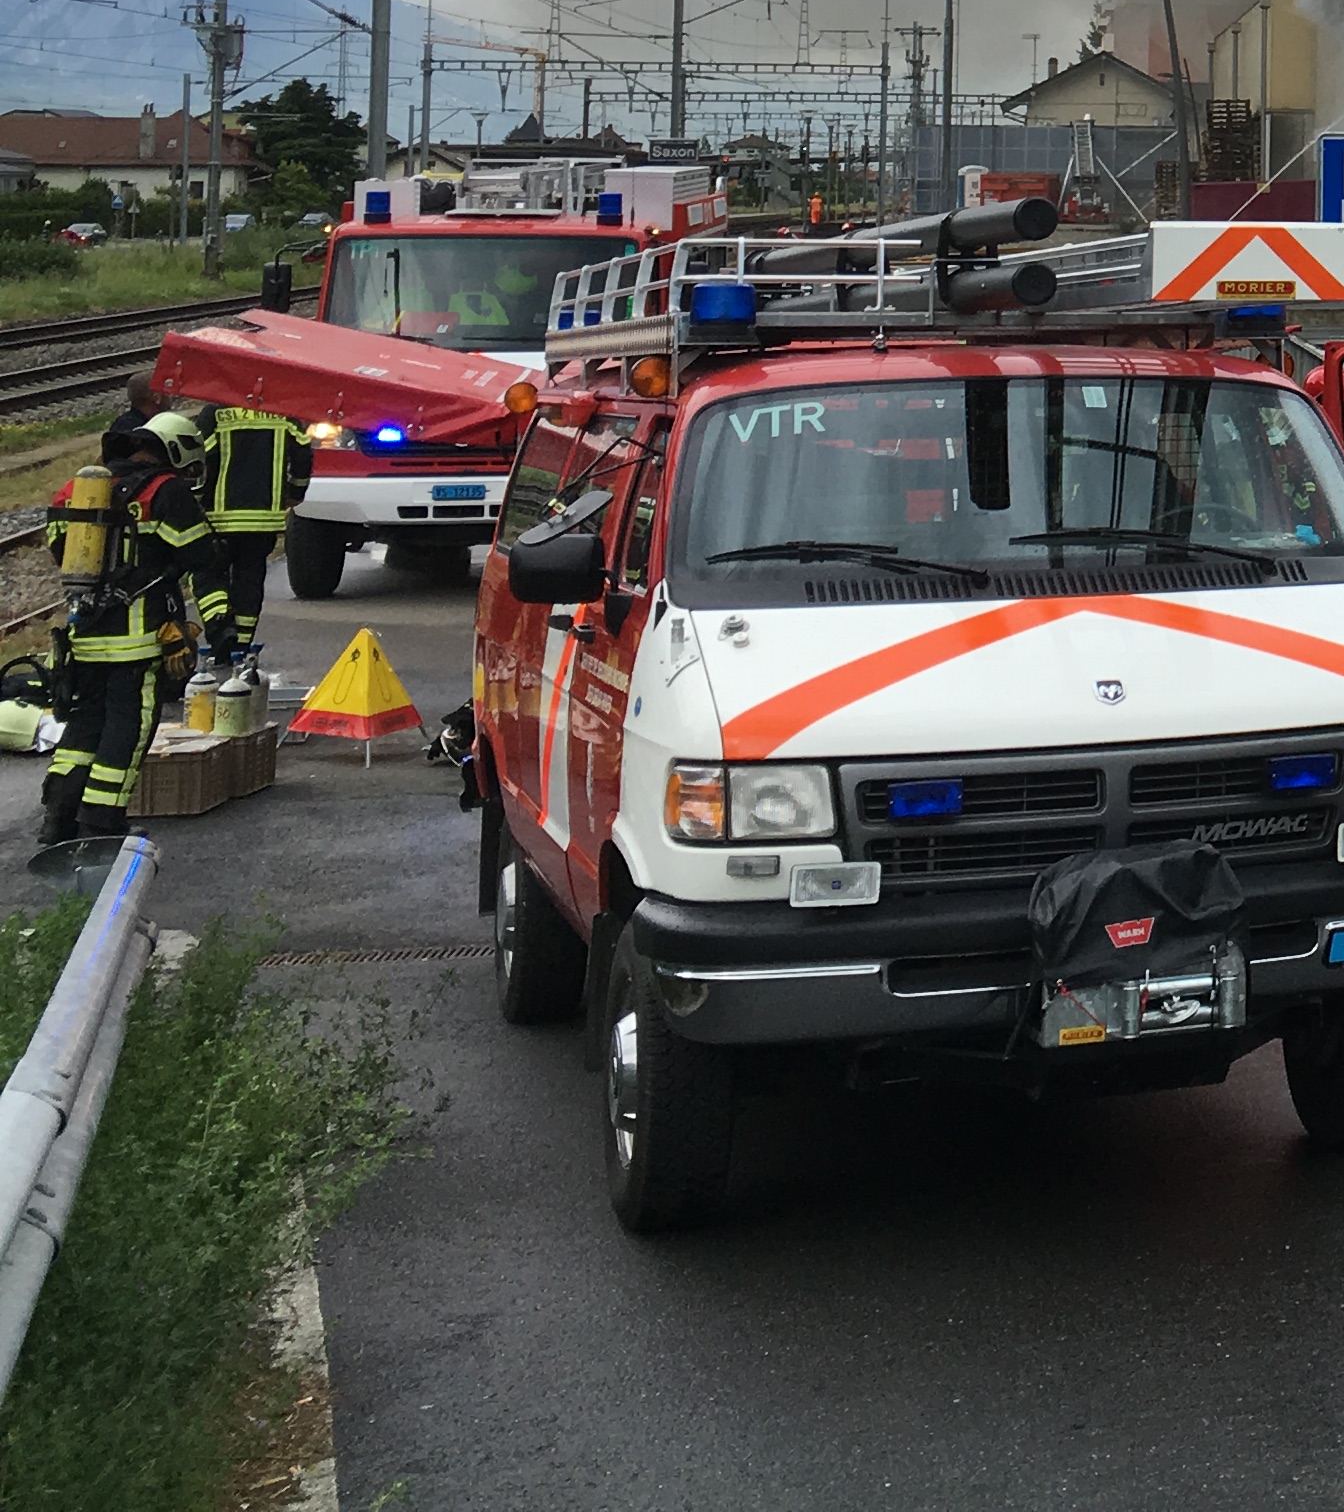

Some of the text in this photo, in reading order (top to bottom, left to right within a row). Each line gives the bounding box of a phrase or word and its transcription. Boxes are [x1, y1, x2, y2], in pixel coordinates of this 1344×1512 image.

[651, 145, 695, 158] Saxon
[1224, 282, 1286, 293] MORIER
[728, 401, 827, 444] VTR
